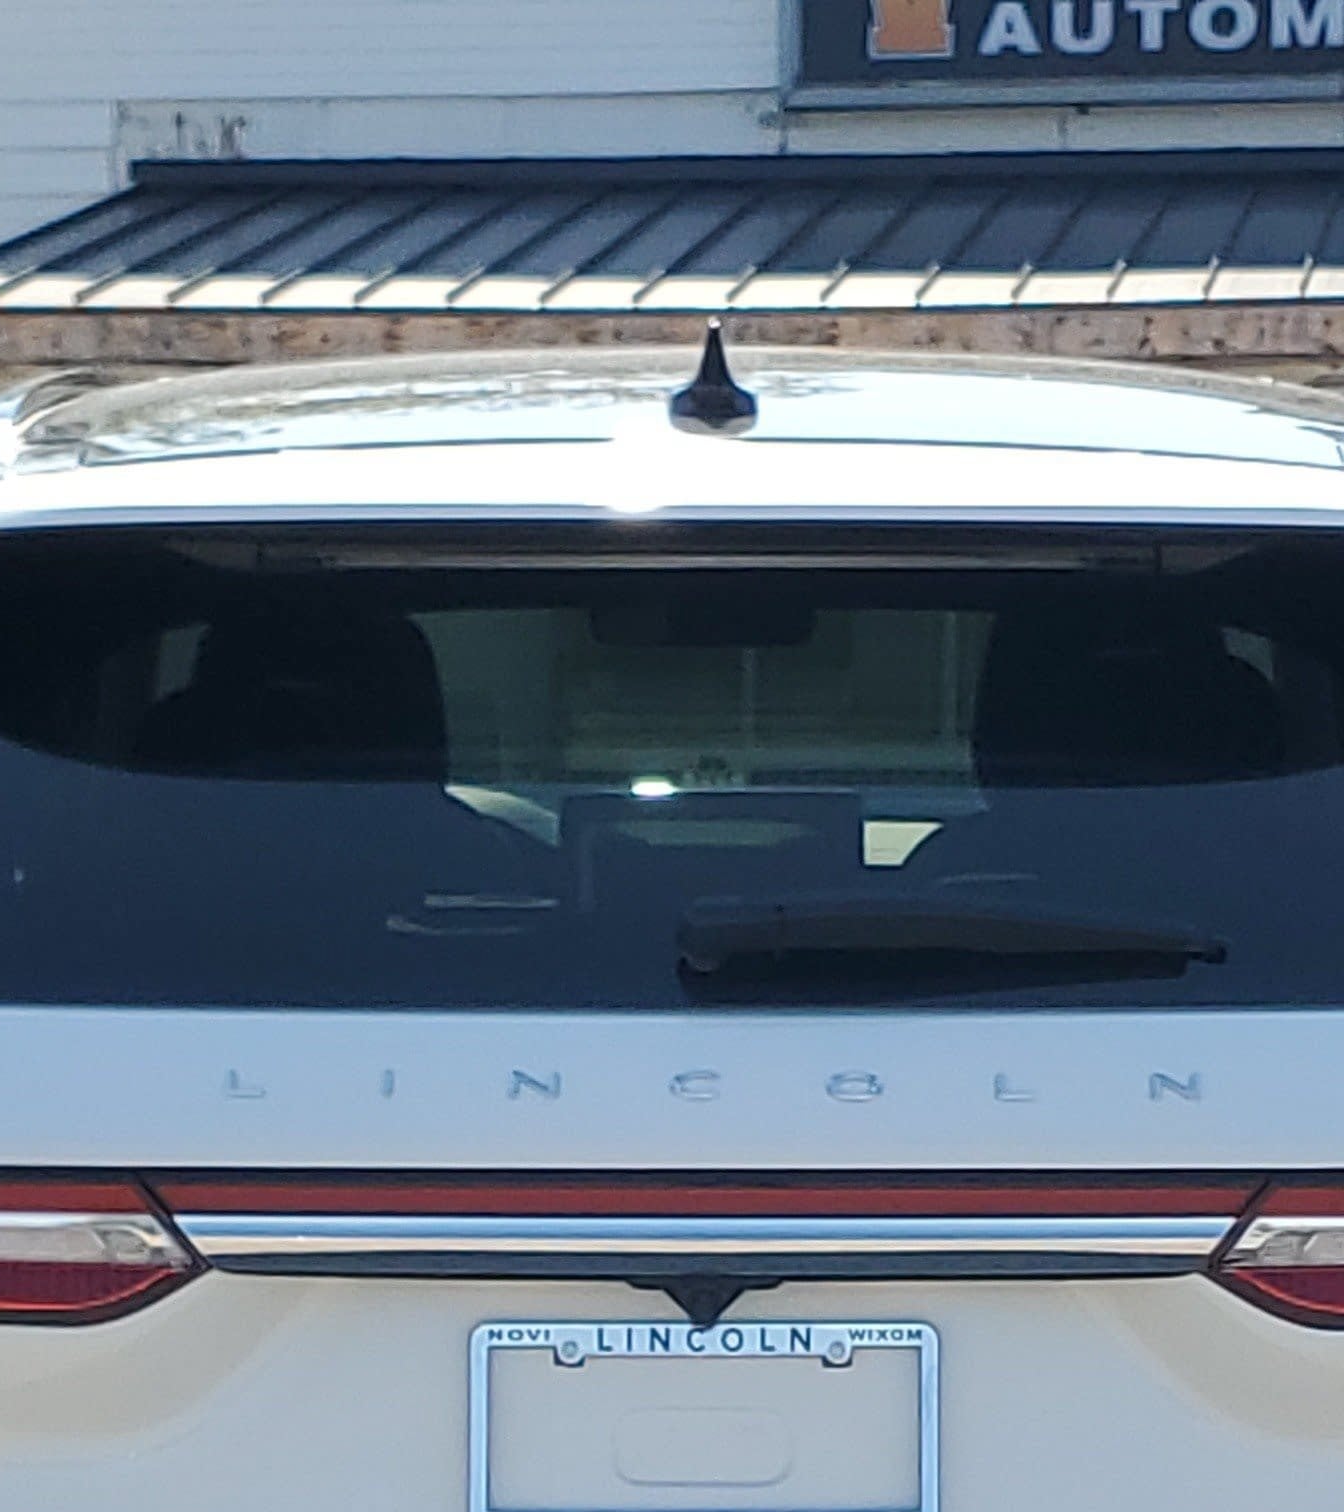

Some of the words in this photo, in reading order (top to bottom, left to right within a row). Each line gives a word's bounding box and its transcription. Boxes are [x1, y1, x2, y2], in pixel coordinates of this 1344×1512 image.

[221, 1066, 1204, 1101] LINCOLN
[488, 1329, 551, 1341] NOVI
[597, 1328, 812, 1352] LINCOLN
[848, 1329, 924, 1341] WIXOM
